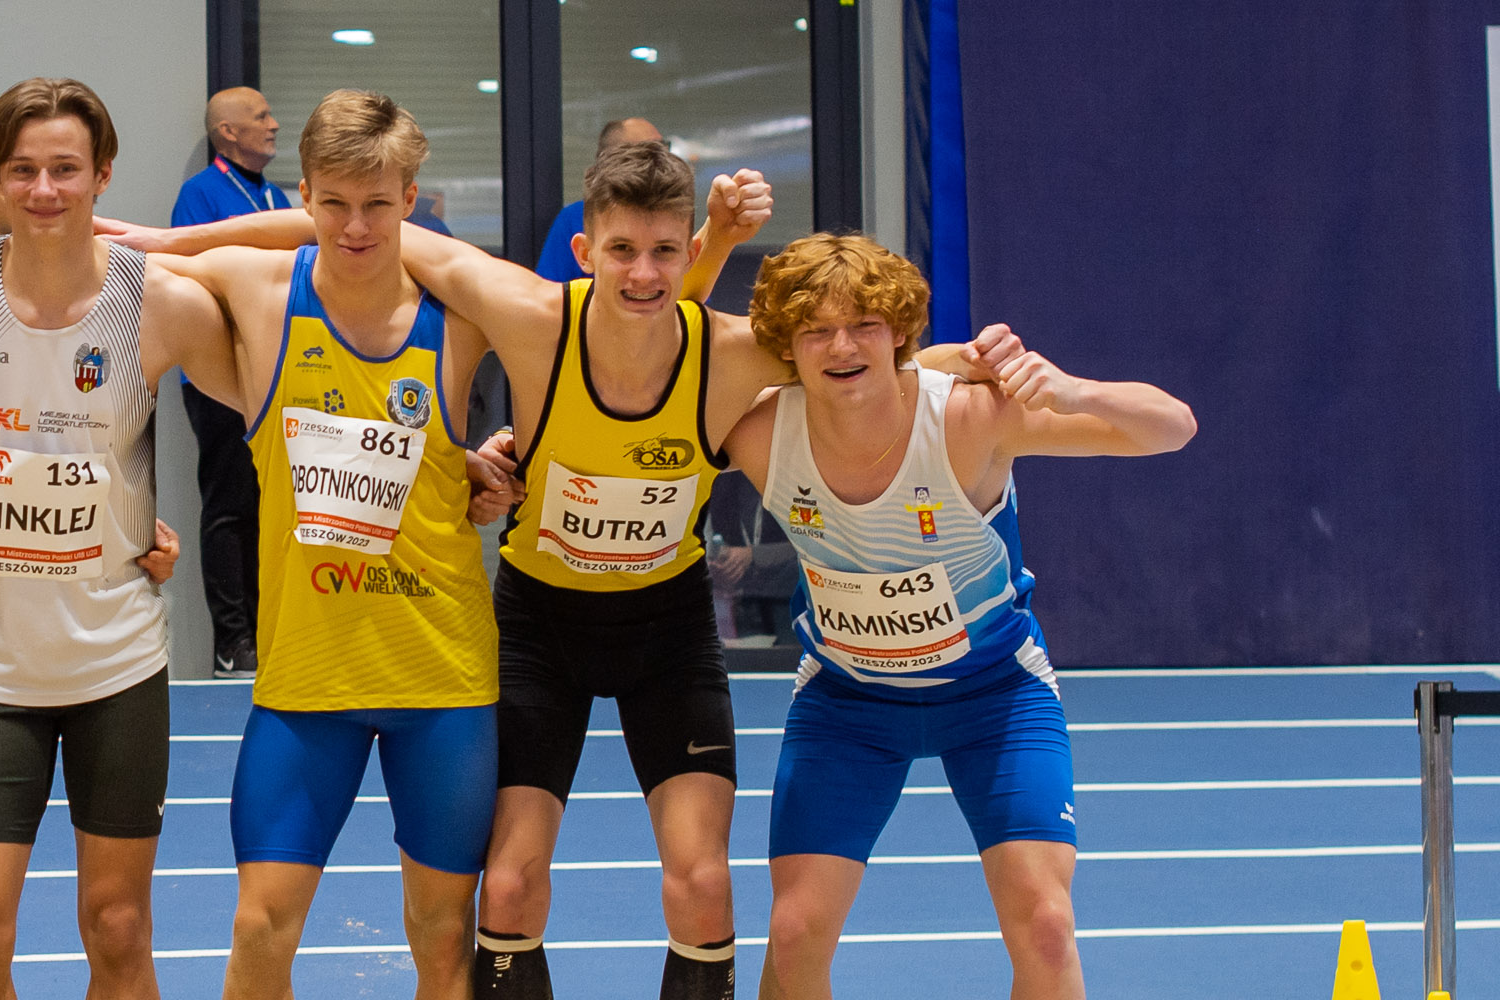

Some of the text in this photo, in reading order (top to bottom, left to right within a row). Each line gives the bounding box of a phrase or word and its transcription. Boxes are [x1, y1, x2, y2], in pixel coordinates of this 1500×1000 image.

[39, 410, 90, 421] MIEJSKI KLU
[360, 427, 411, 461] 861
[640, 450, 680, 466] OSA
[47, 461, 98, 486] 131
[291, 464, 409, 512] OBOTNIKOWSKI
[640, 486, 678, 505] 52
[562, 490, 599, 506] ORLEN
[562, 510, 667, 541] BUTRA
[790, 526, 825, 540] GDAŃSK
[301, 528, 370, 548] ZESZÓW 2023
[6, 550, 51, 560] Mistrzostwa
[563, 553, 654, 572] RZESZÓW 2023
[47, 566, 77, 575] 2023
[823, 578, 862, 590] rzeszów
[879, 572, 935, 598] 643
[818, 601, 954, 636] KAMIŃSKI
[852, 654, 942, 668] RZESZÓW 2023
